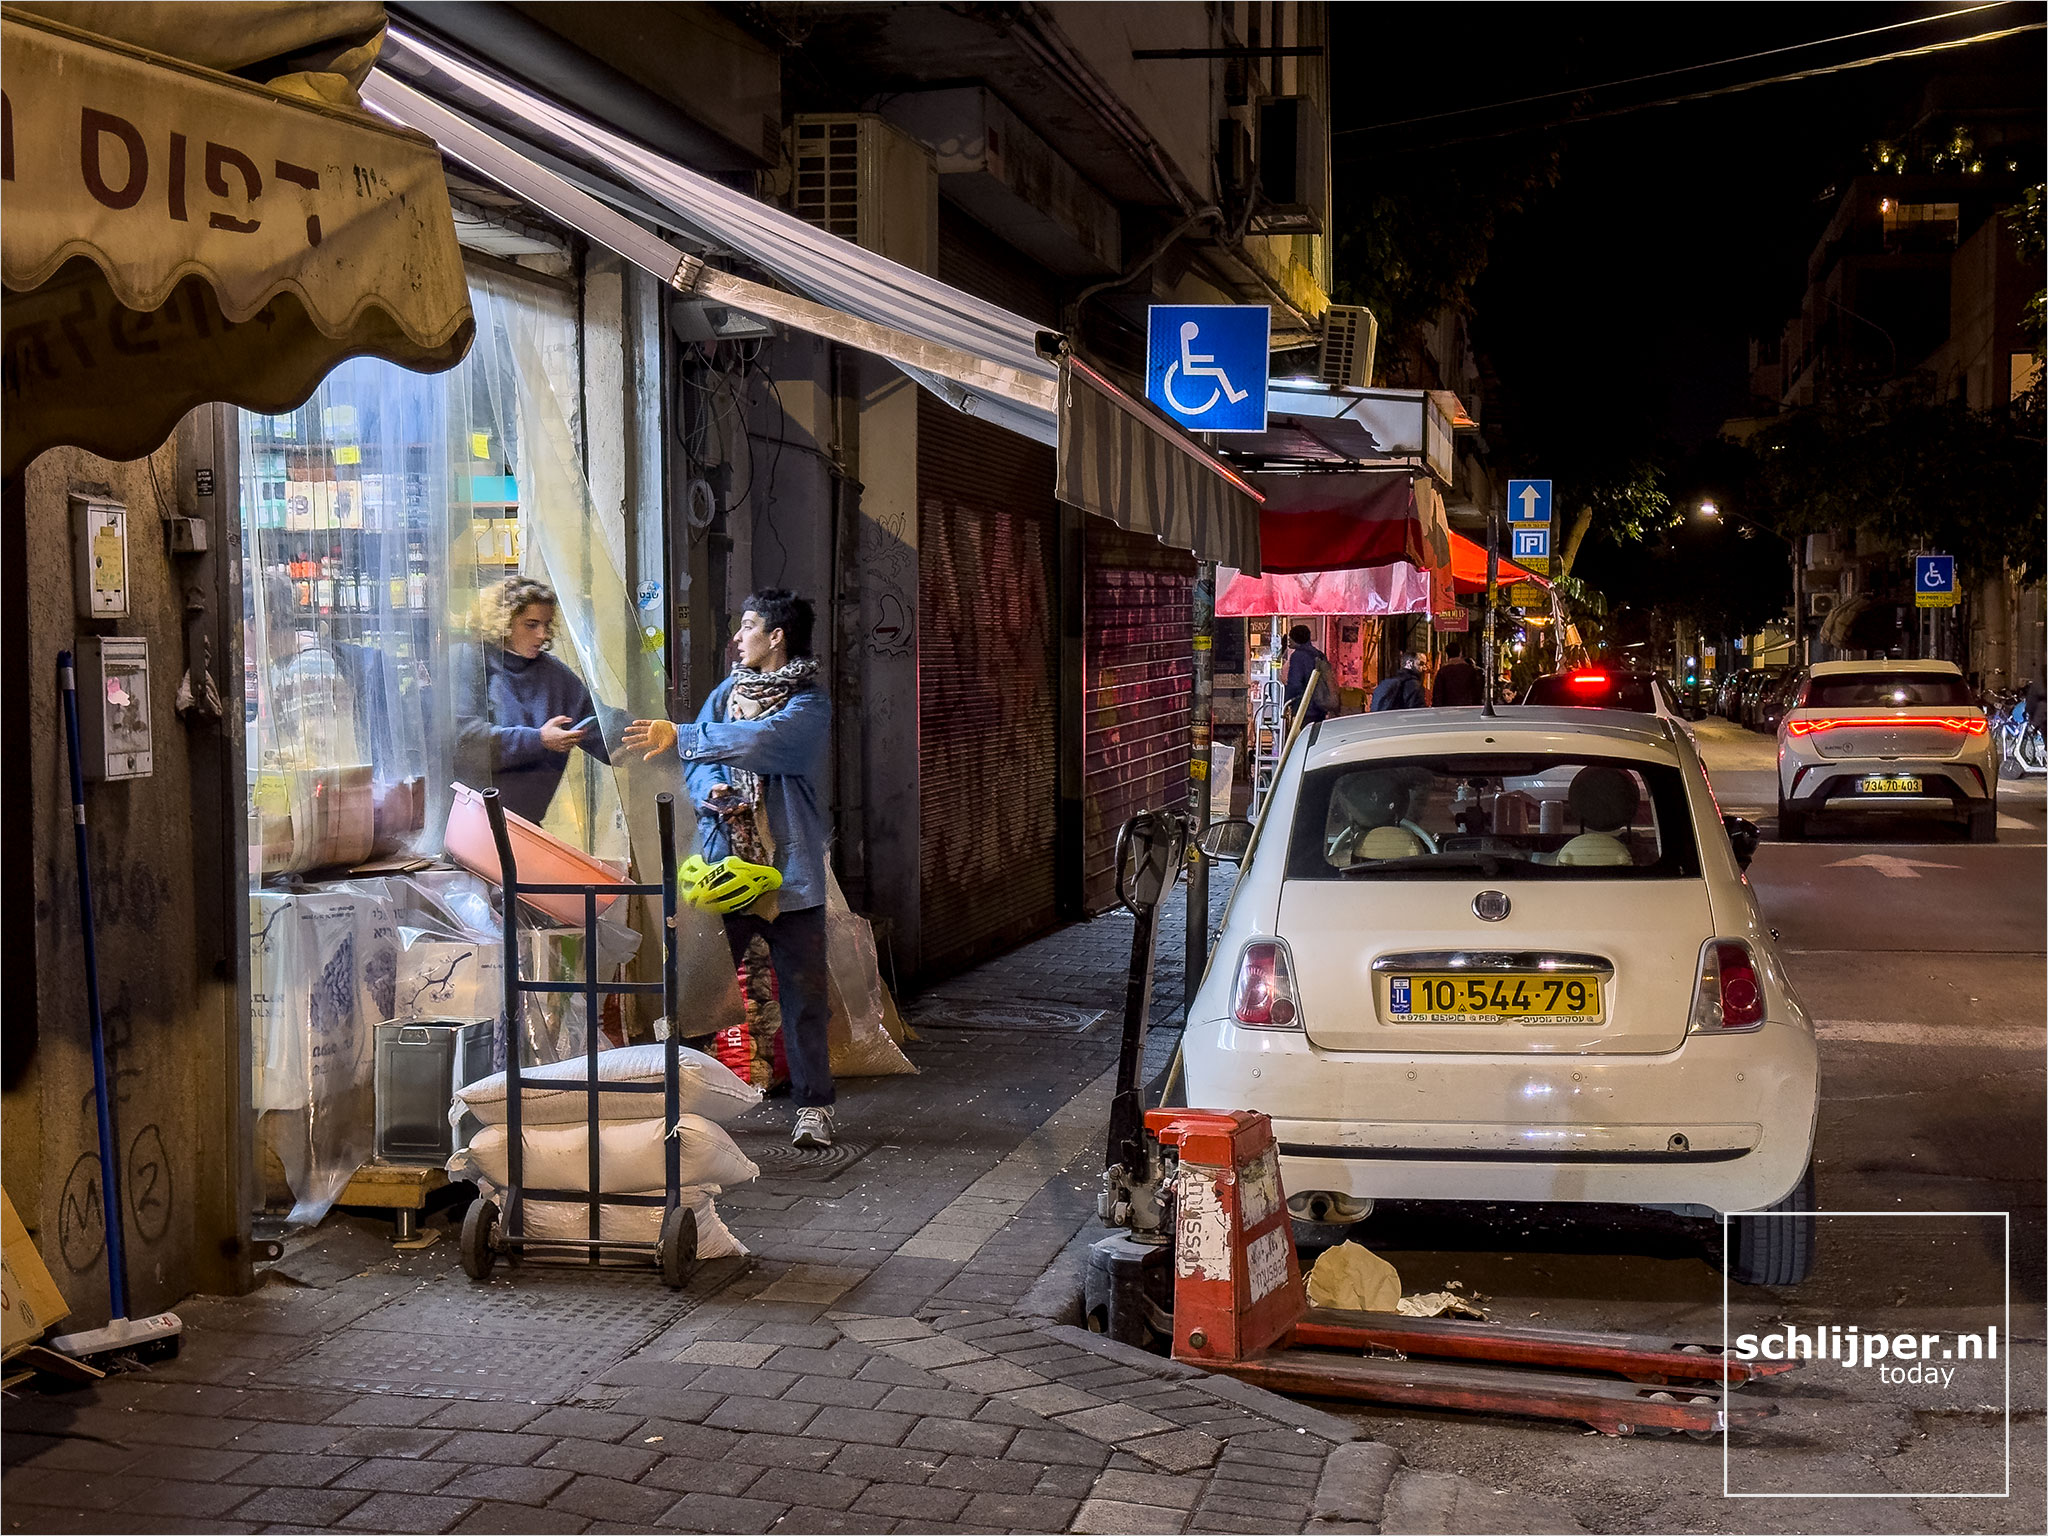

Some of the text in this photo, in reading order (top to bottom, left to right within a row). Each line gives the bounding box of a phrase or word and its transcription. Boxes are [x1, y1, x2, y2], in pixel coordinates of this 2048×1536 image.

[80, 105, 323, 248] דפוס
[697, 863, 726, 889] BELL
[1396, 989, 1408, 1004] IL
[137, 1162, 161, 1213] 2
